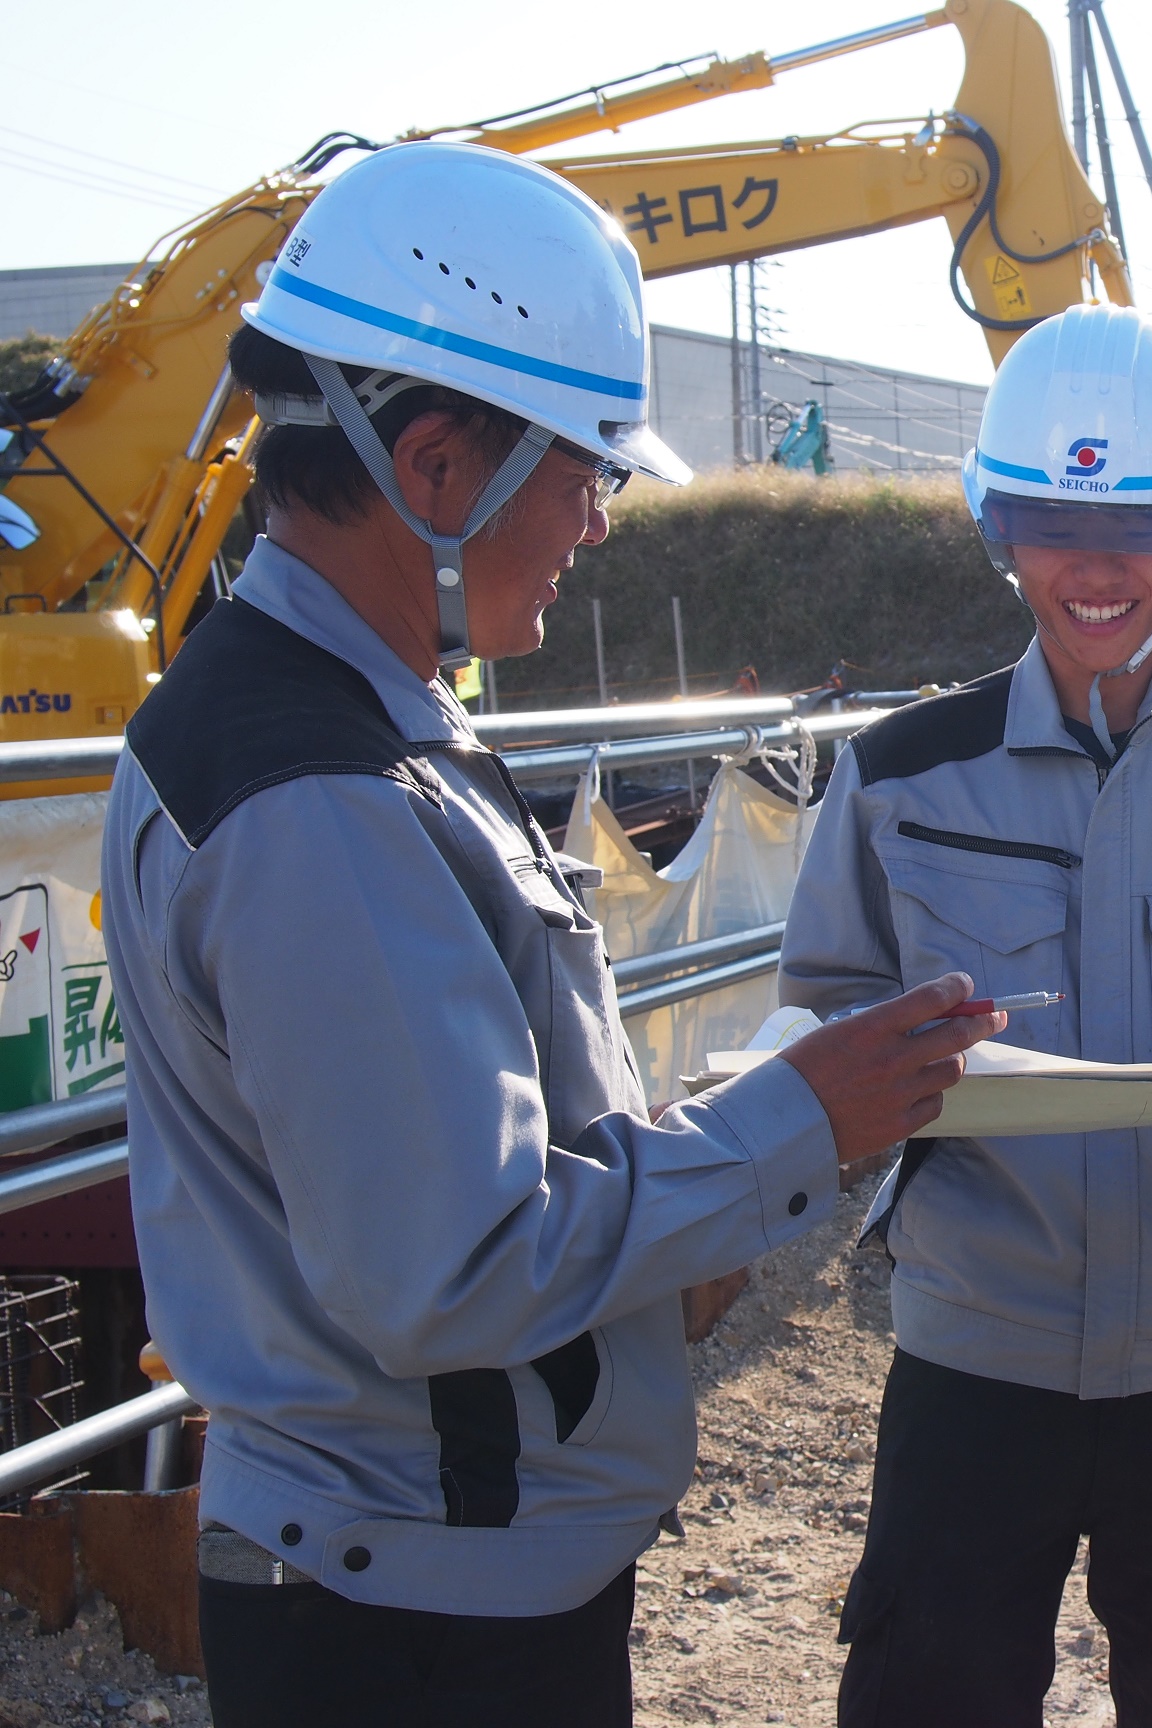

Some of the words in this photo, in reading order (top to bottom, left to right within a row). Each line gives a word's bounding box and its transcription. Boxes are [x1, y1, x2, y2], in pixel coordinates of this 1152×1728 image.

[601, 177, 778, 244] キロク
[286, 236, 312, 267] B型
[1058, 478, 1109, 493] SEICHO
